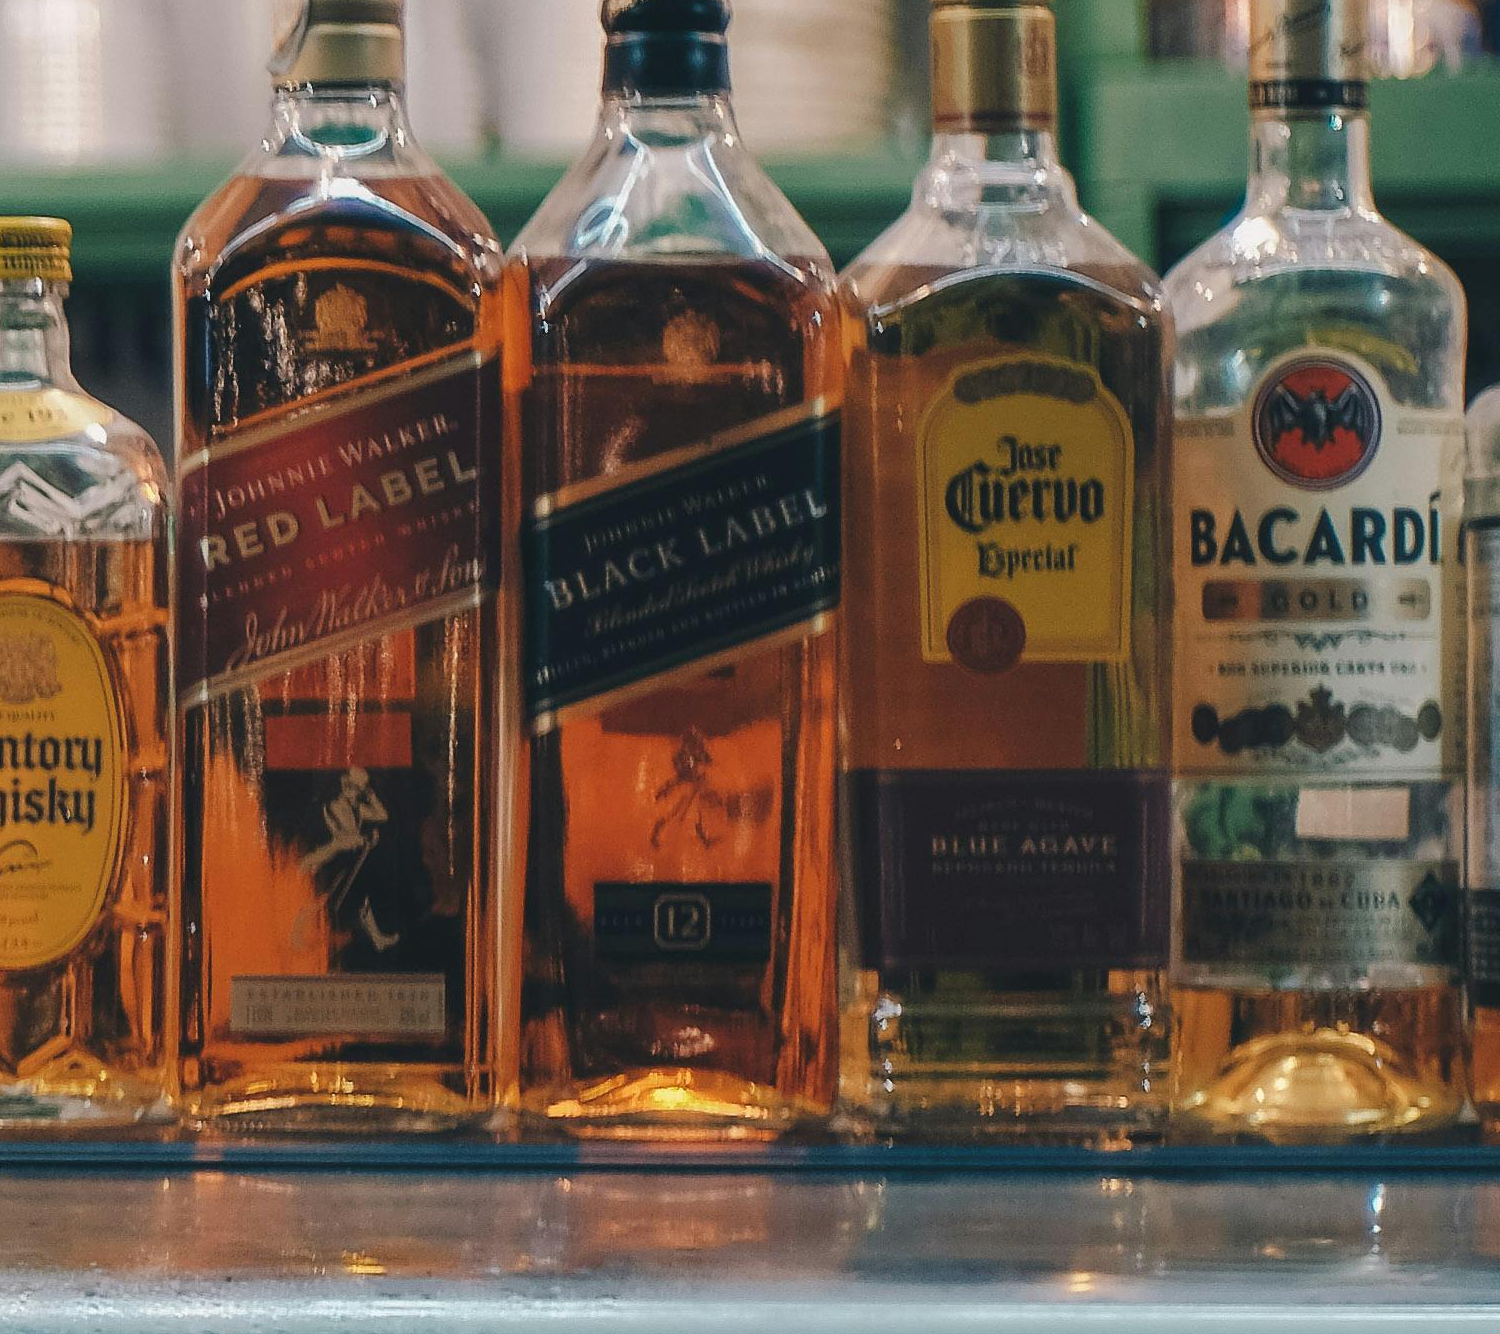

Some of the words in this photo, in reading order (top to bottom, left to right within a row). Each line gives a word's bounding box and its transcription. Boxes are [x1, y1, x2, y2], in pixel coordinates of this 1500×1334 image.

[199, 510, 300, 572] RED
[315, 449, 478, 530] LABEL
[945, 459, 1106, 536] Cuervo
[1189, 493, 1442, 568] BACARDÍ
[544, 538, 685, 610] BLACK
[698, 489, 829, 556] LABEL
[666, 902, 700, 937] 12
